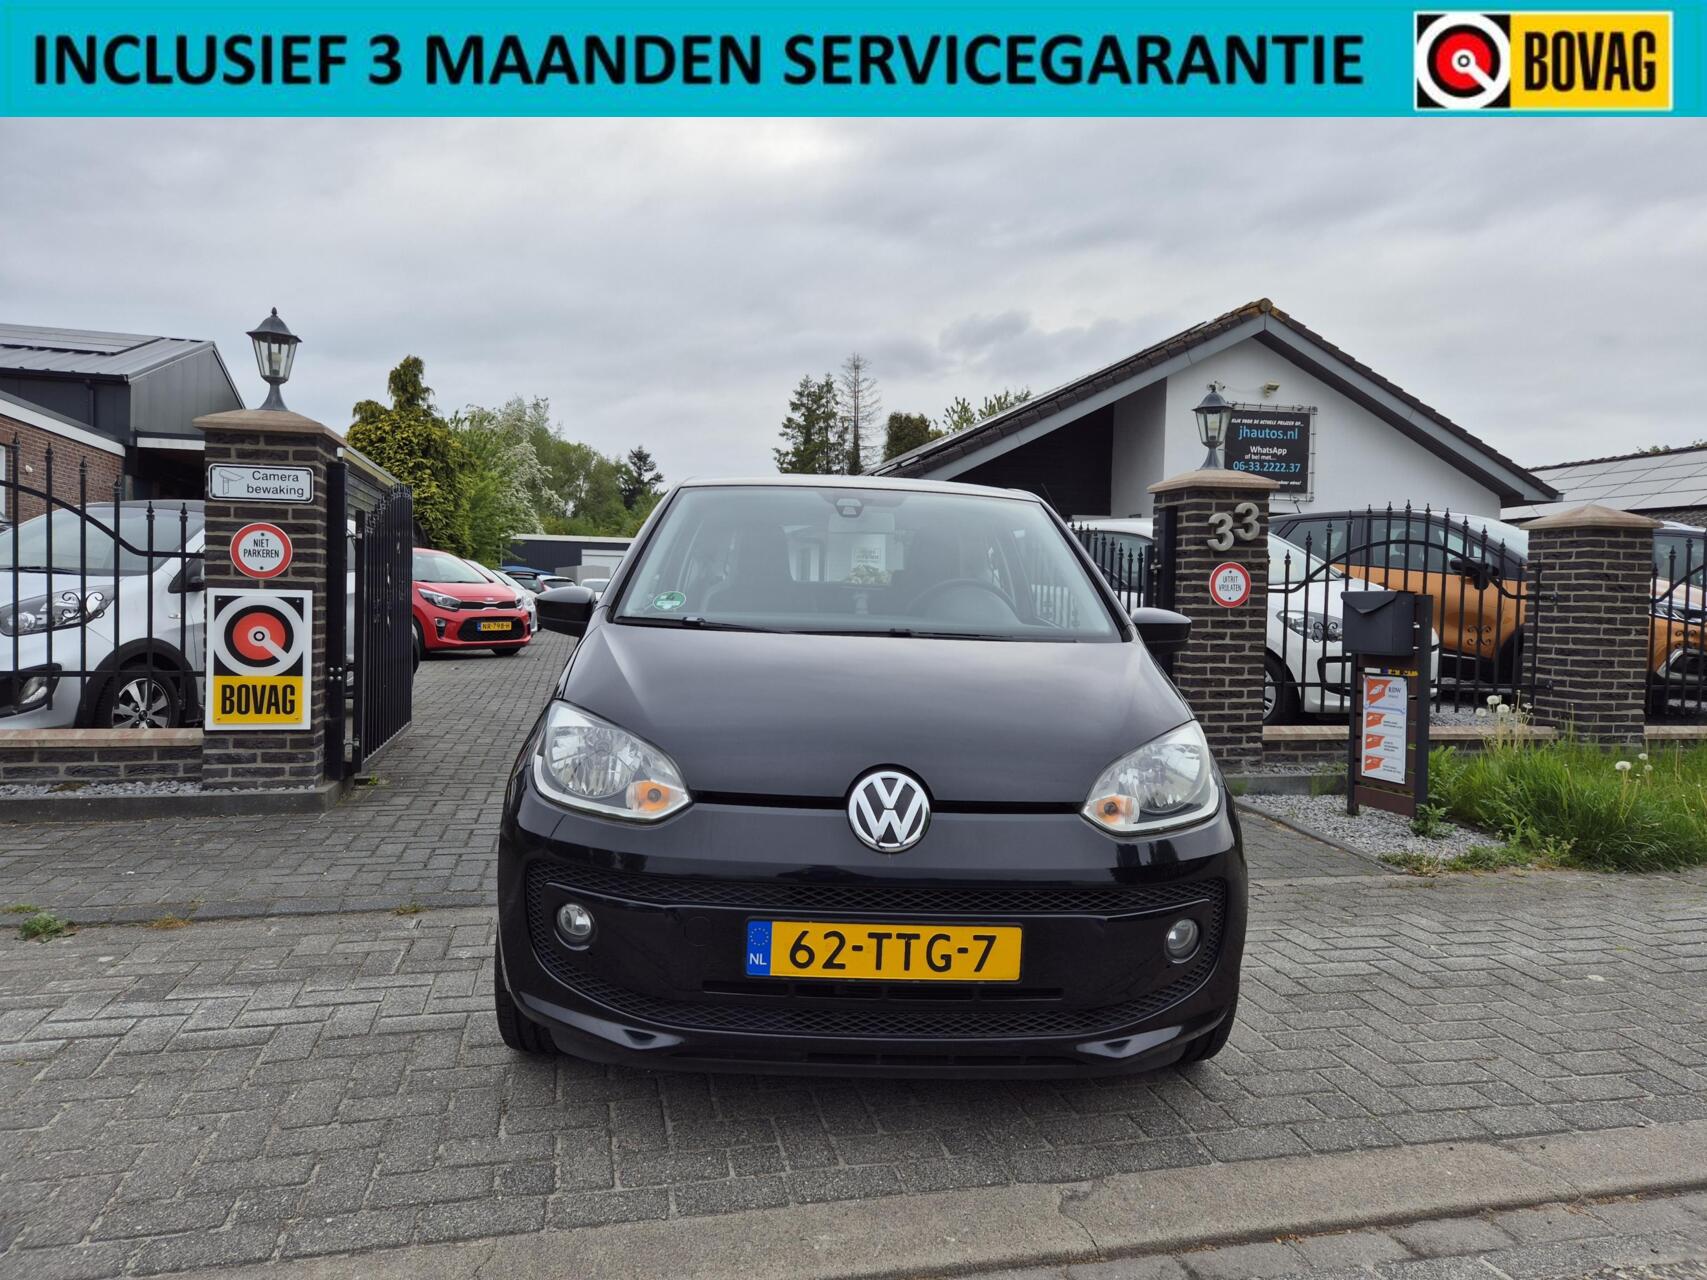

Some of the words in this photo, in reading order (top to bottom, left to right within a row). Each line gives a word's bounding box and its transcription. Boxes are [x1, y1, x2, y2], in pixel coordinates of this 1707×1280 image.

[1238, 425, 1298, 440] jhautos.nl
[1250, 446, 1287, 455] WhatsApp
[1233, 460, 1301, 473] 06-33.2222.37
[252, 470, 299, 482] Camera
[246, 483, 304, 498] bewaking
[1207, 502, 1260, 552] 33
[253, 538, 269, 548] NIET
[243, 548, 280, 558] PARKEREN
[1222, 575, 1239, 583] UITRIT
[221, 684, 296, 715] BOVAG
[789, 930, 997, 973] 62-TTG-7
[749, 953, 767, 966] NL
